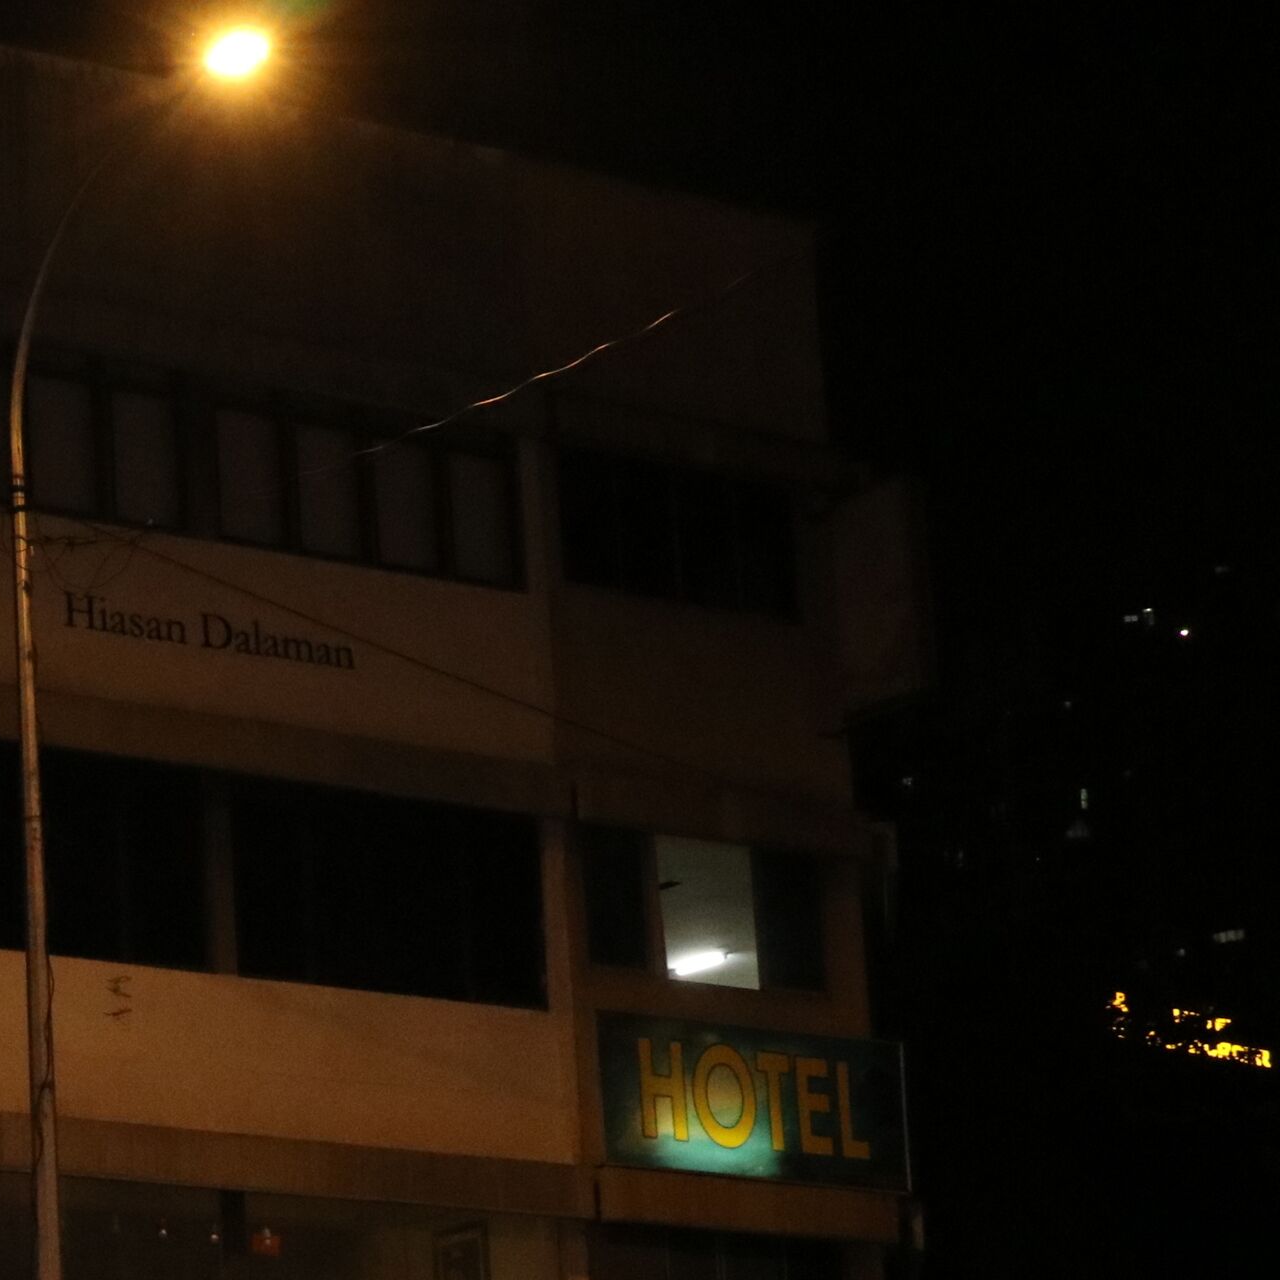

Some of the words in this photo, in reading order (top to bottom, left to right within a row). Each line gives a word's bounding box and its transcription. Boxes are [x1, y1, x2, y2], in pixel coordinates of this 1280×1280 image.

[64, 590, 187, 645] Hiasan
[200, 614, 355, 670] Dalaman
[637, 1037, 871, 1160] HOTEL
